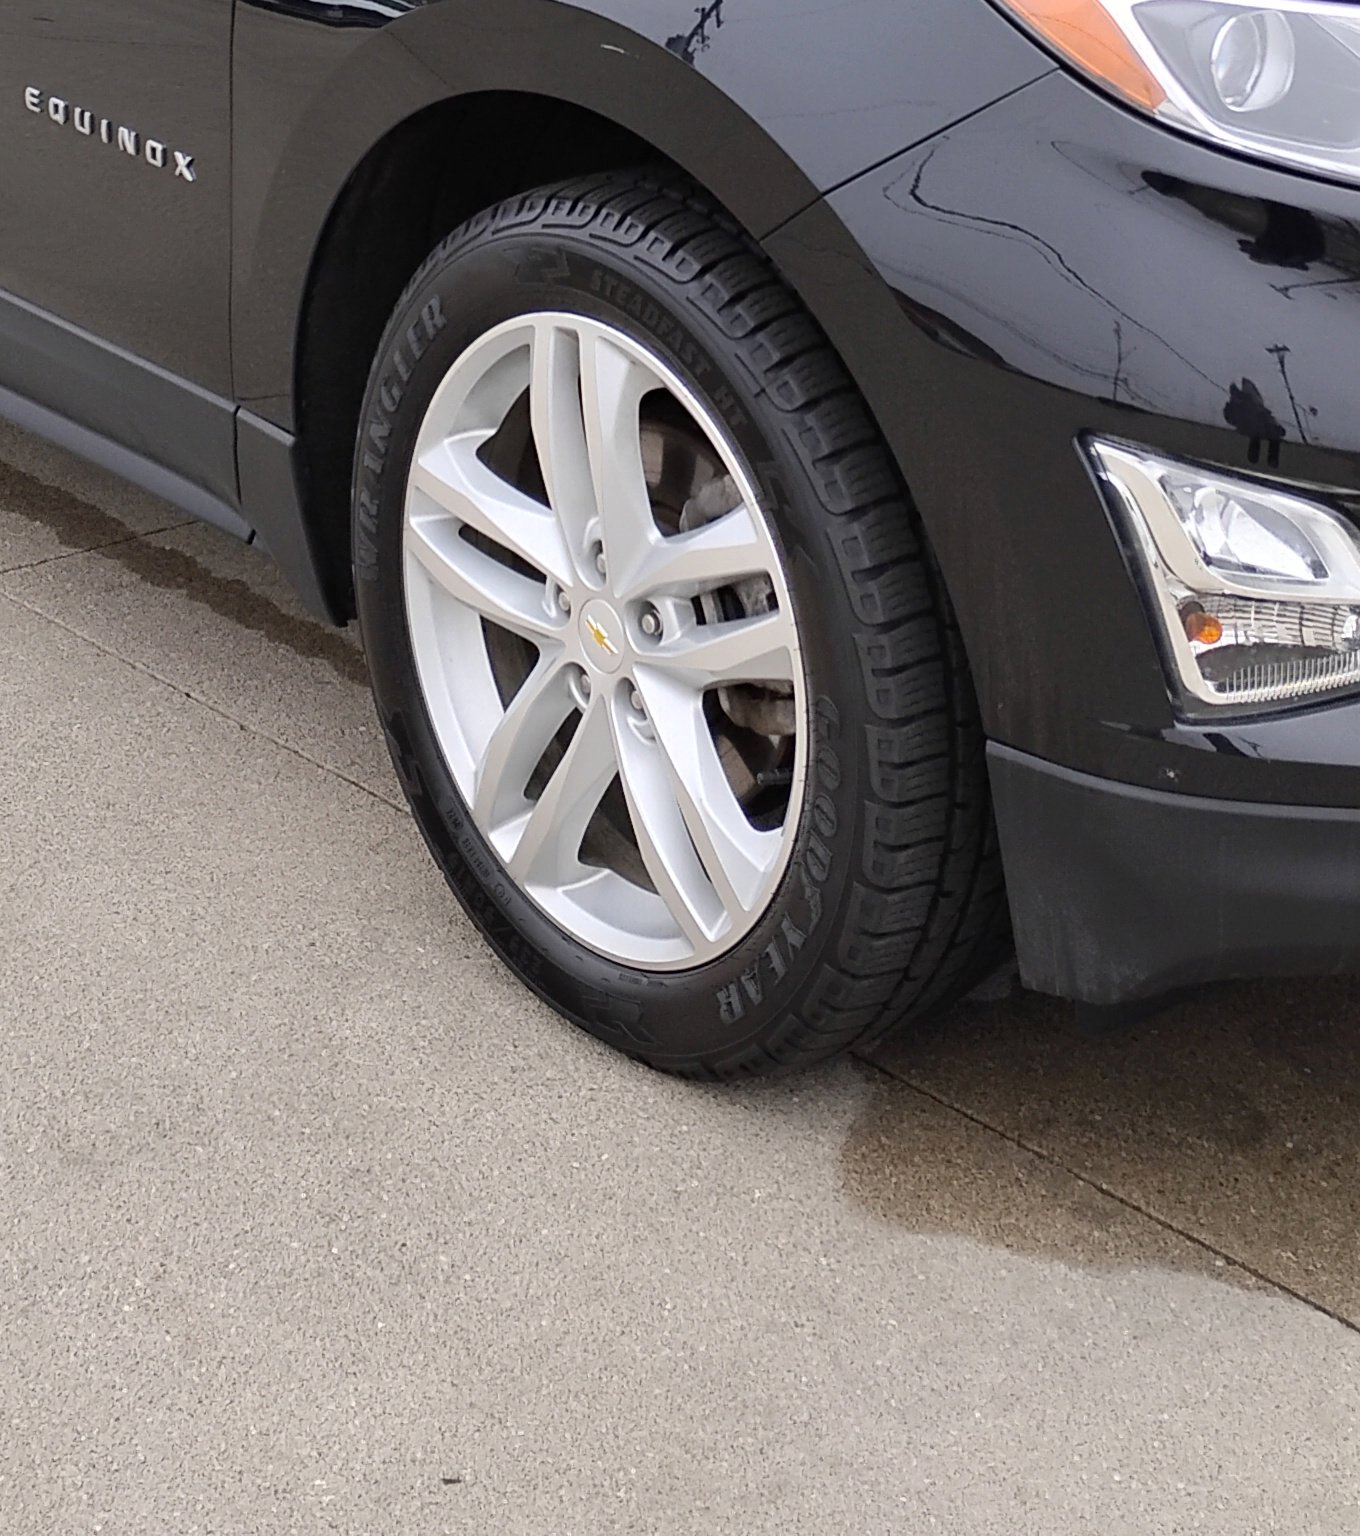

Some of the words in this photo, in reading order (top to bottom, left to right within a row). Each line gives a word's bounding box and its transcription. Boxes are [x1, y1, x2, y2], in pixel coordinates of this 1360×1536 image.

[24, 86, 197, 182] EQUINOX
[590, 268, 711, 378] STEADFAST
[357, 294, 448, 582] WRANGLER
[714, 694, 840, 1026] GOODYEAR
